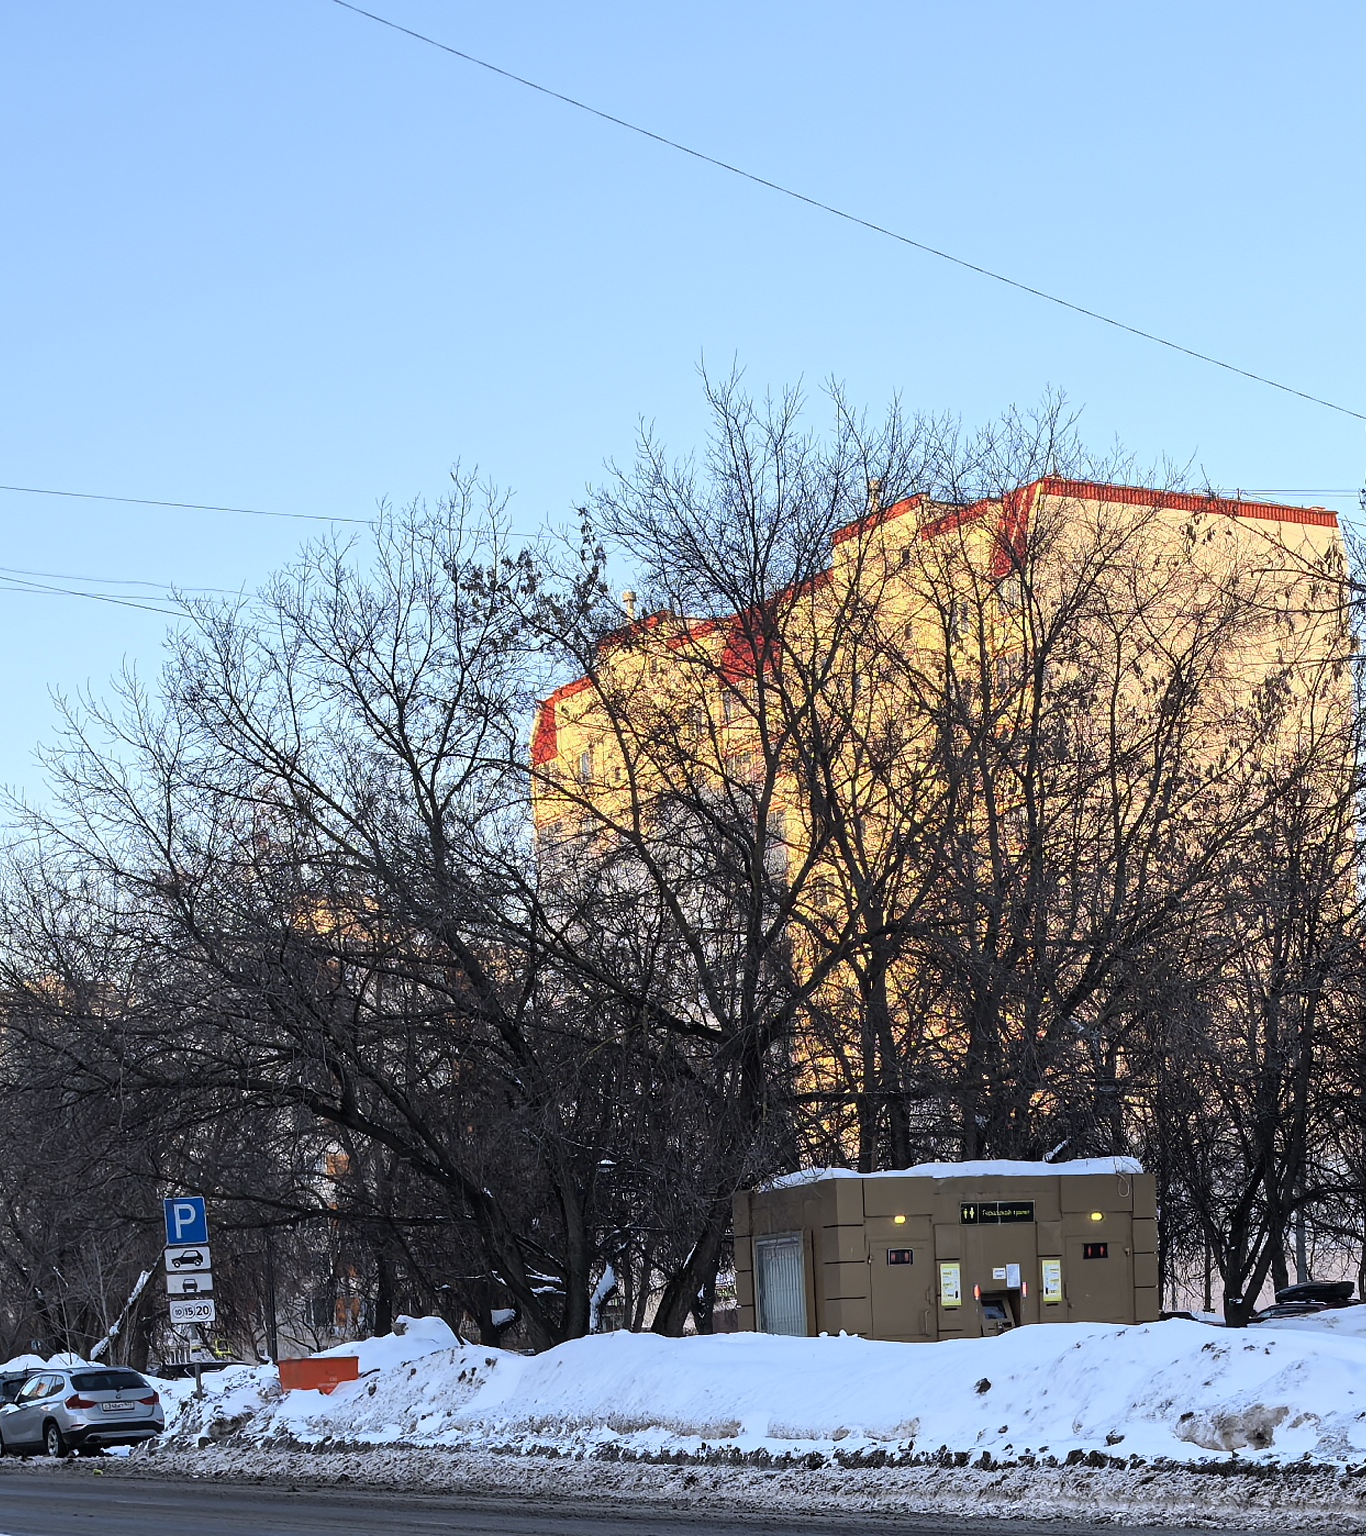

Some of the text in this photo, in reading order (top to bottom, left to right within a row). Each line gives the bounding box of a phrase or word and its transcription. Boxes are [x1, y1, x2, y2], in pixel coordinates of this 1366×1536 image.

[173, 1204, 196, 1239] P
[185, 1307, 193, 1315] 15
[196, 1305, 209, 1315] 20
